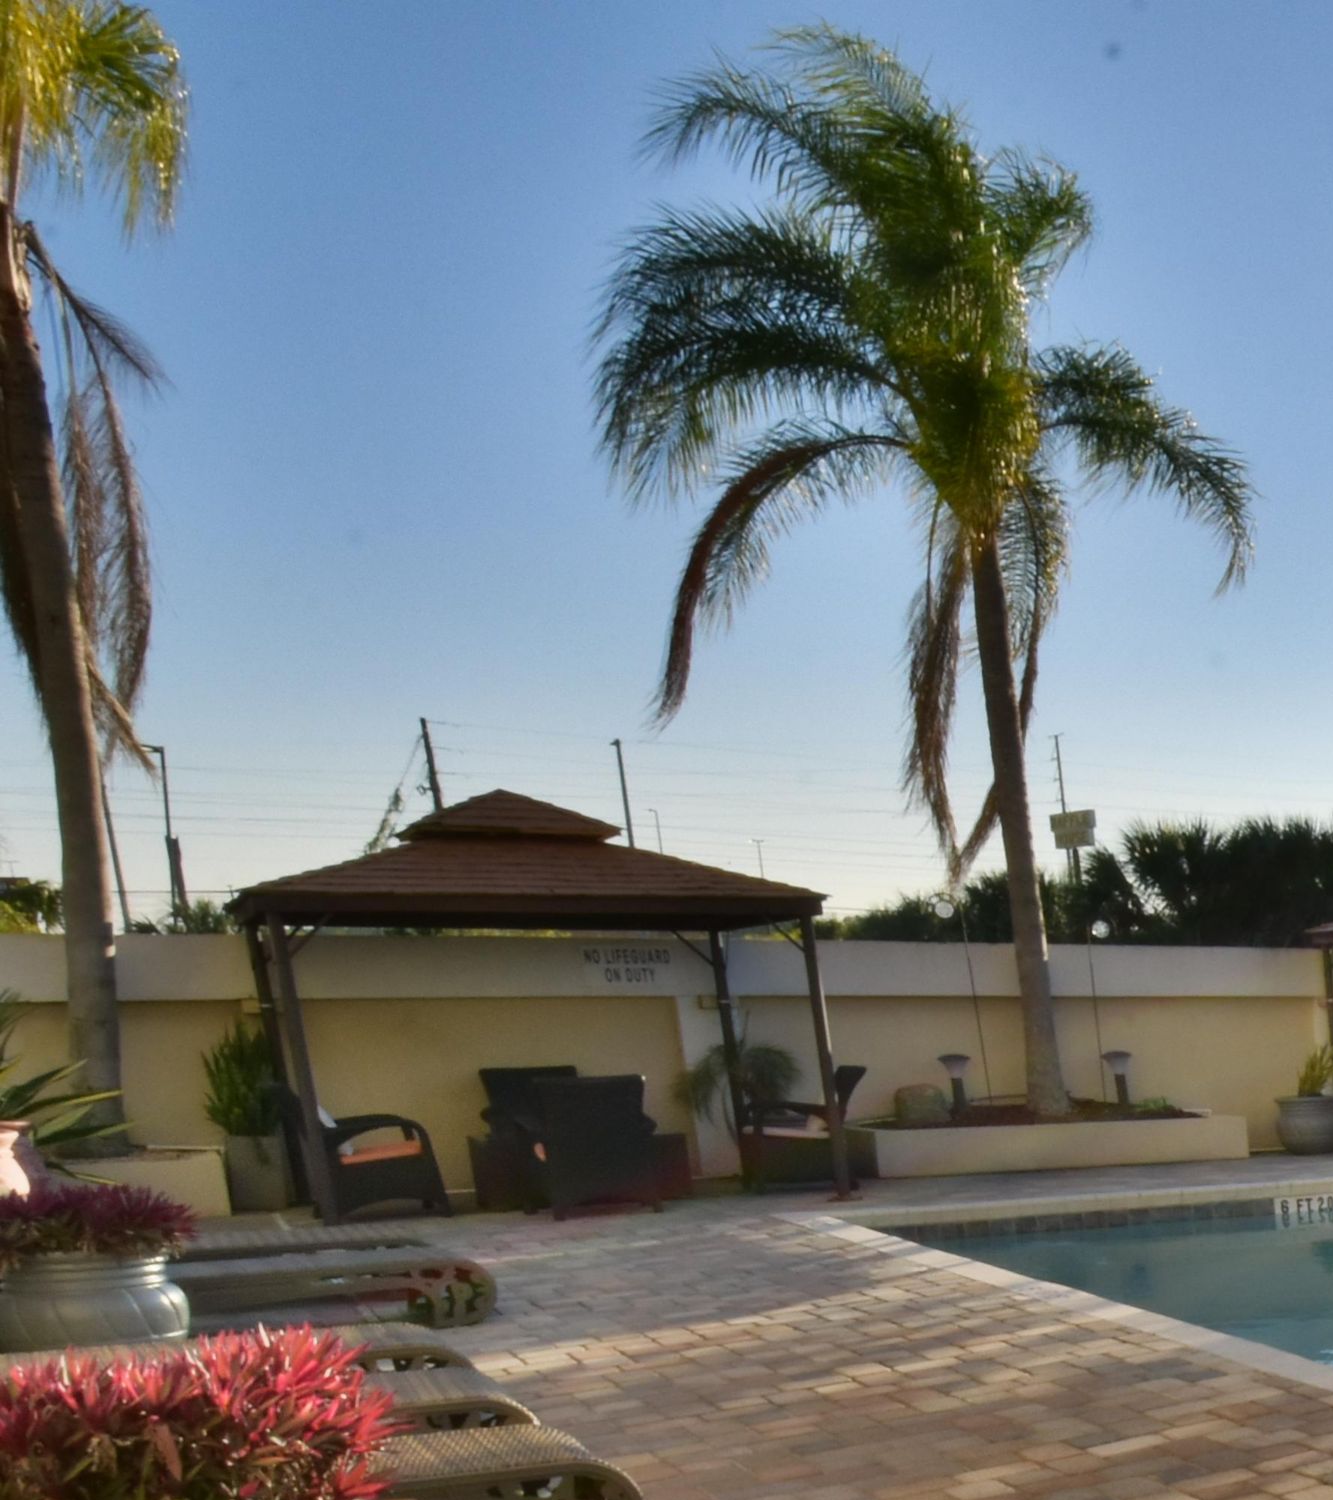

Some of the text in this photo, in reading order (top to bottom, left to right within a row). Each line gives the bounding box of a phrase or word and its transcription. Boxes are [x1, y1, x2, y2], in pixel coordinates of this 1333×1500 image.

[583, 949, 671, 964] NO LIFEGUARD
[605, 967, 656, 982] ON DUTY
